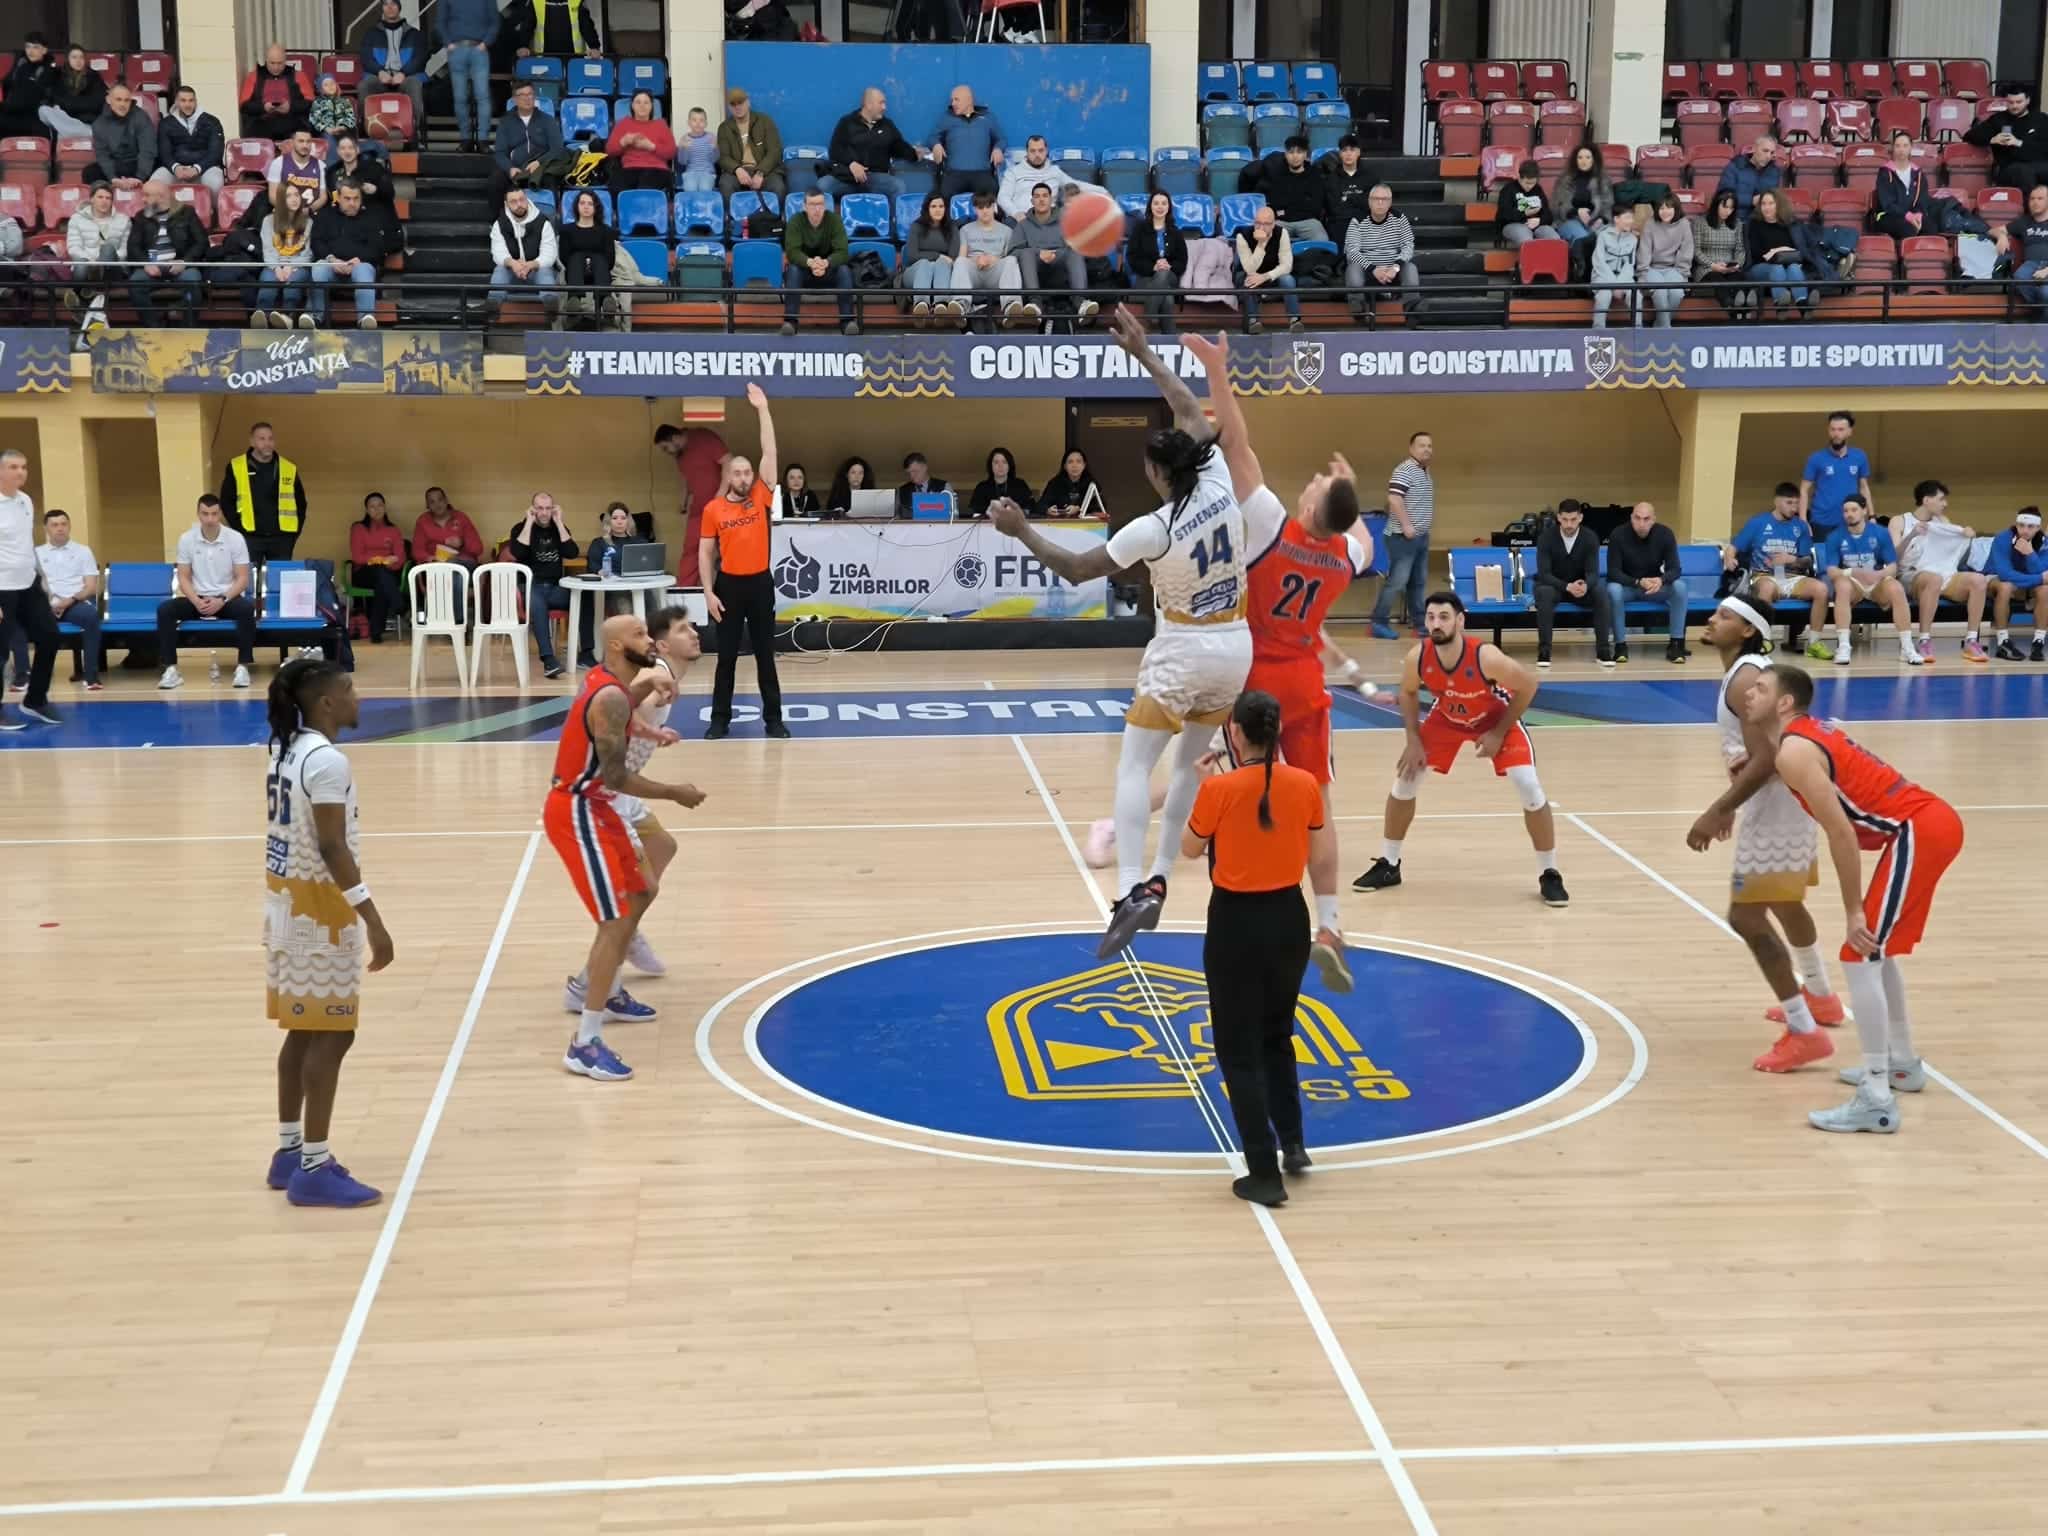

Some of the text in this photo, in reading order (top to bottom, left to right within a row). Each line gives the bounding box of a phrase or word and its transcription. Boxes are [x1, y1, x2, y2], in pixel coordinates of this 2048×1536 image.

[266, 334, 309, 361] Visit
[1691, 344, 1944, 368] O MARE DE SPORTIVI
[227, 352, 350, 389] CONSTANȚA
[568, 351, 864, 378] #TEAMISEVERYTHING
[1340, 349, 1574, 377] CSM CONSTANȚA
[718, 512, 761, 530] LINKSOFT
[1190, 523, 1233, 579] 14
[829, 563, 870, 578] LIGA
[995, 556, 1079, 587] FR
[829, 580, 930, 594] ZIMBRILOR
[1271, 573, 1321, 620] 21
[326, 1005, 354, 1016] CSU
